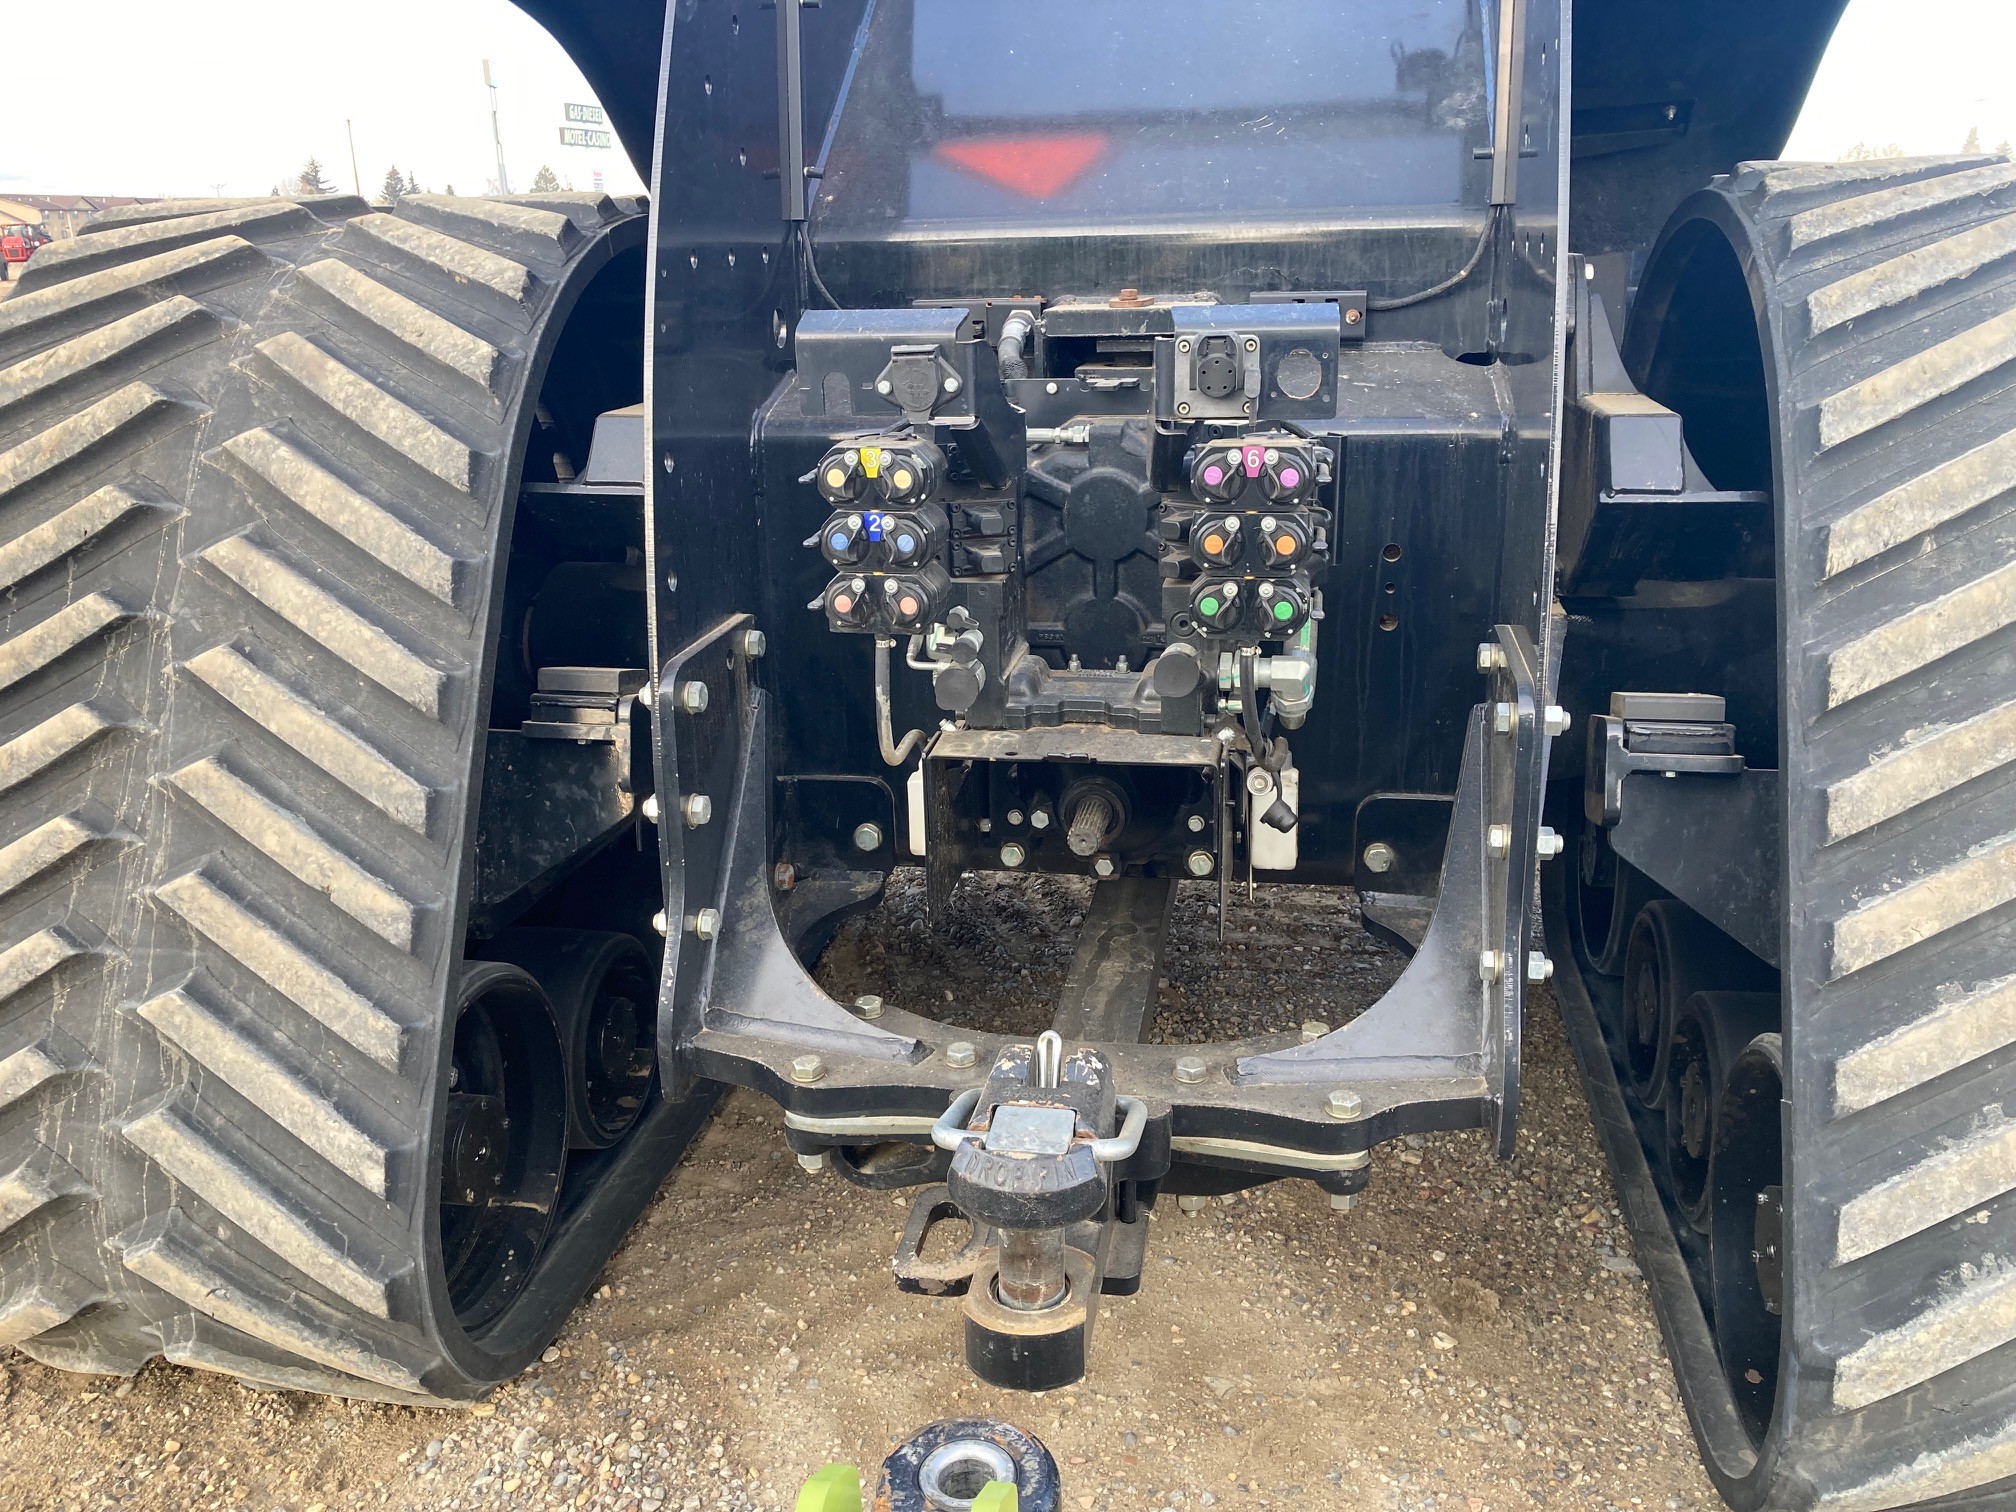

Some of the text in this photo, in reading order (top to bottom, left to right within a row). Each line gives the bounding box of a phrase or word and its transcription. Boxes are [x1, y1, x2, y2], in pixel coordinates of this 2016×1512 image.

[865, 449, 877, 468] 3
[1247, 449, 1260, 468] 6
[868, 514, 881, 532] 2
[964, 1151, 1078, 1191] DROP PIN
